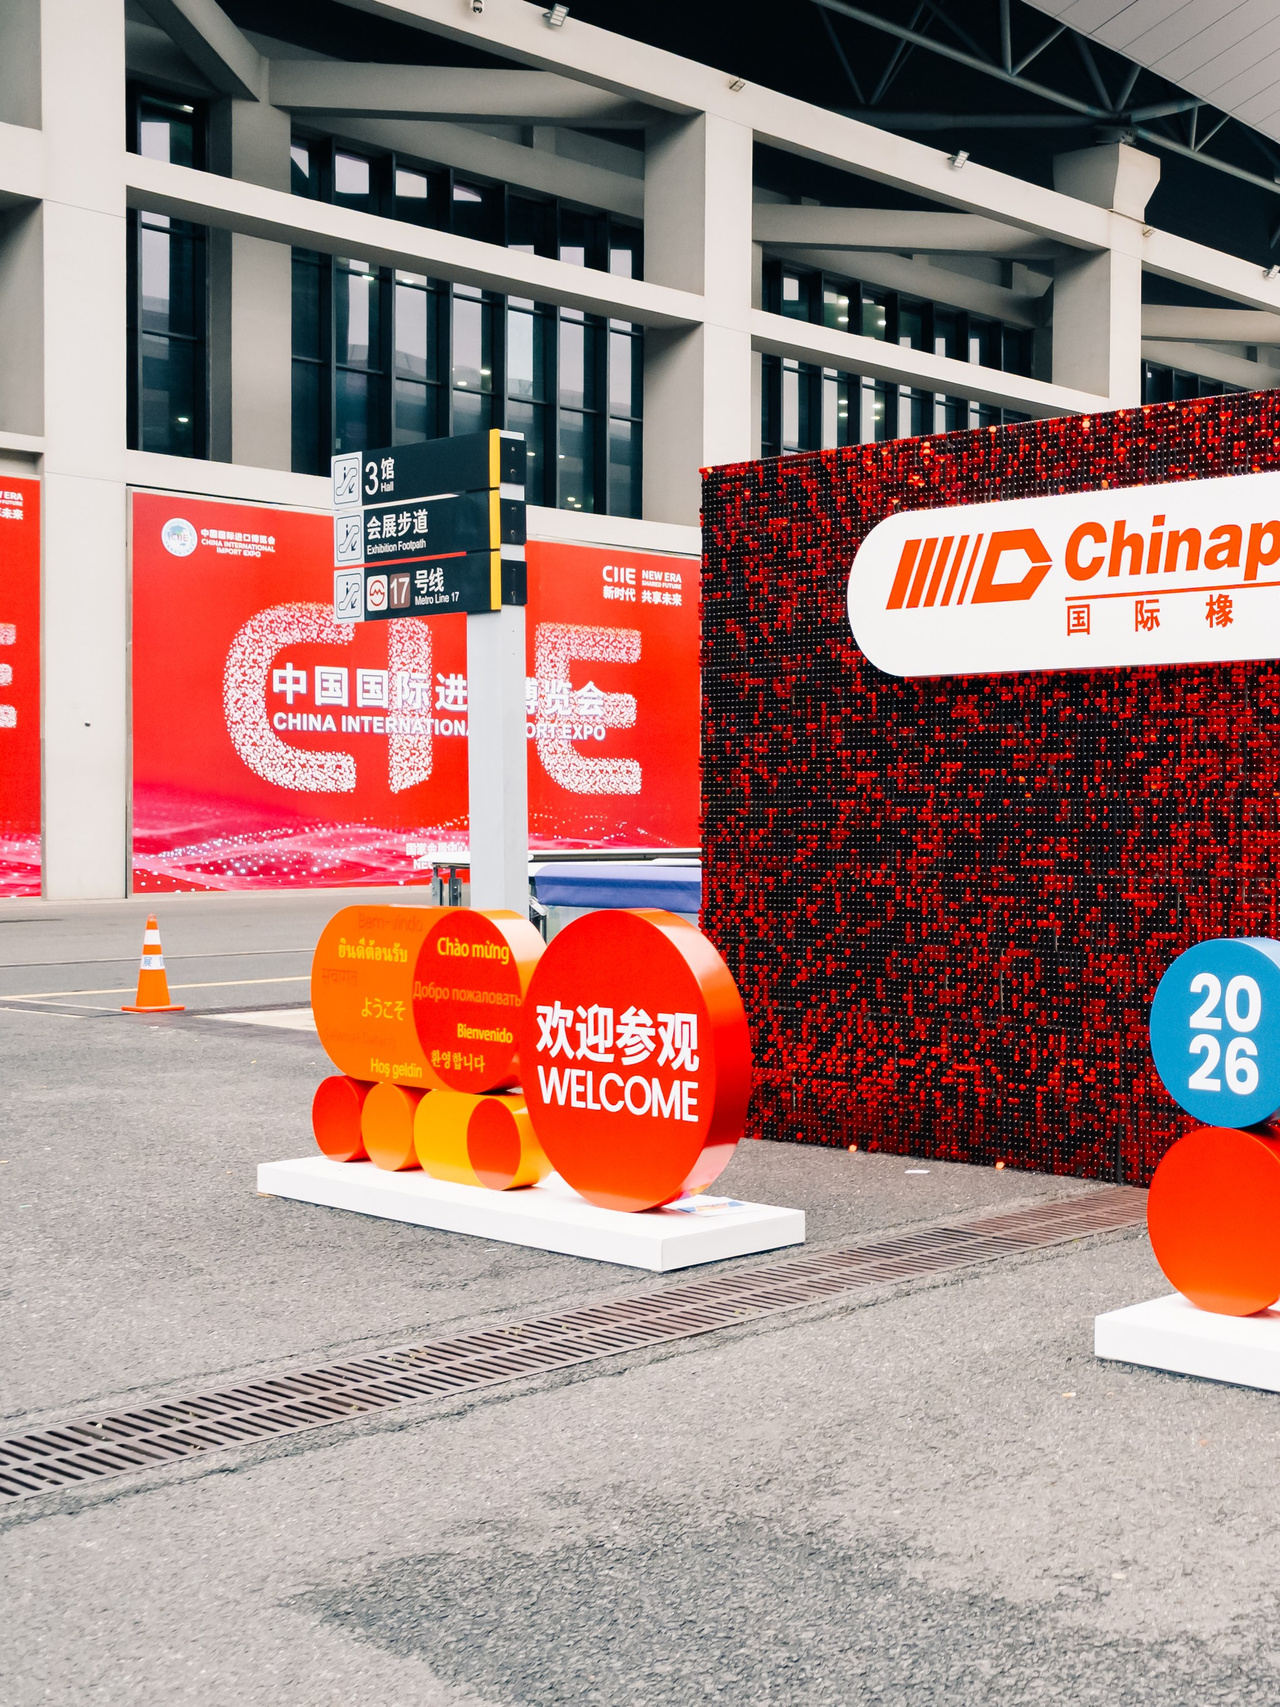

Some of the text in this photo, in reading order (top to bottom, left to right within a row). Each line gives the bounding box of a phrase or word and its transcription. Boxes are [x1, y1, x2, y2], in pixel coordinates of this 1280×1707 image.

[381, 481, 395, 493] Hall
[0, 507, 24, 520] 未来
[366, 508, 429, 541] 会展步道
[201, 538, 276, 553] CHINA INTERNATIONAL
[216, 547, 262, 558] IMPORT EXPO
[366, 538, 427, 555] Exhibition Footpath
[602, 565, 636, 585] CIIE
[641, 569, 682, 583] NEW ERA
[603, 585, 682, 606] 新时代 共享未来
[662, 582, 682, 590] FUTURE
[414, 592, 460, 606] Metro Line 17
[273, 711, 337, 733] CHINA
[341, 715, 468, 739] INTERNATION
[564, 722, 607, 741] EXPO
[358, 913, 424, 932] Bem-vindo
[338, 936, 408, 963] ยินดีต้อนรับ
[437, 937, 510, 965] Chào mừng
[413, 981, 522, 1008] Добро пожаловать
[1188, 972, 1262, 1032] 20
[361, 997, 407, 1021] ようこそ
[457, 1023, 514, 1044] Bienvenido
[536, 1000, 700, 1072] 欢迎参观
[370, 1057, 423, 1079] Hoş geldin
[431, 1049, 486, 1073] 환영합니다
[1188, 1033, 1260, 1095] 26
[537, 1065, 699, 1123] WELCOME
